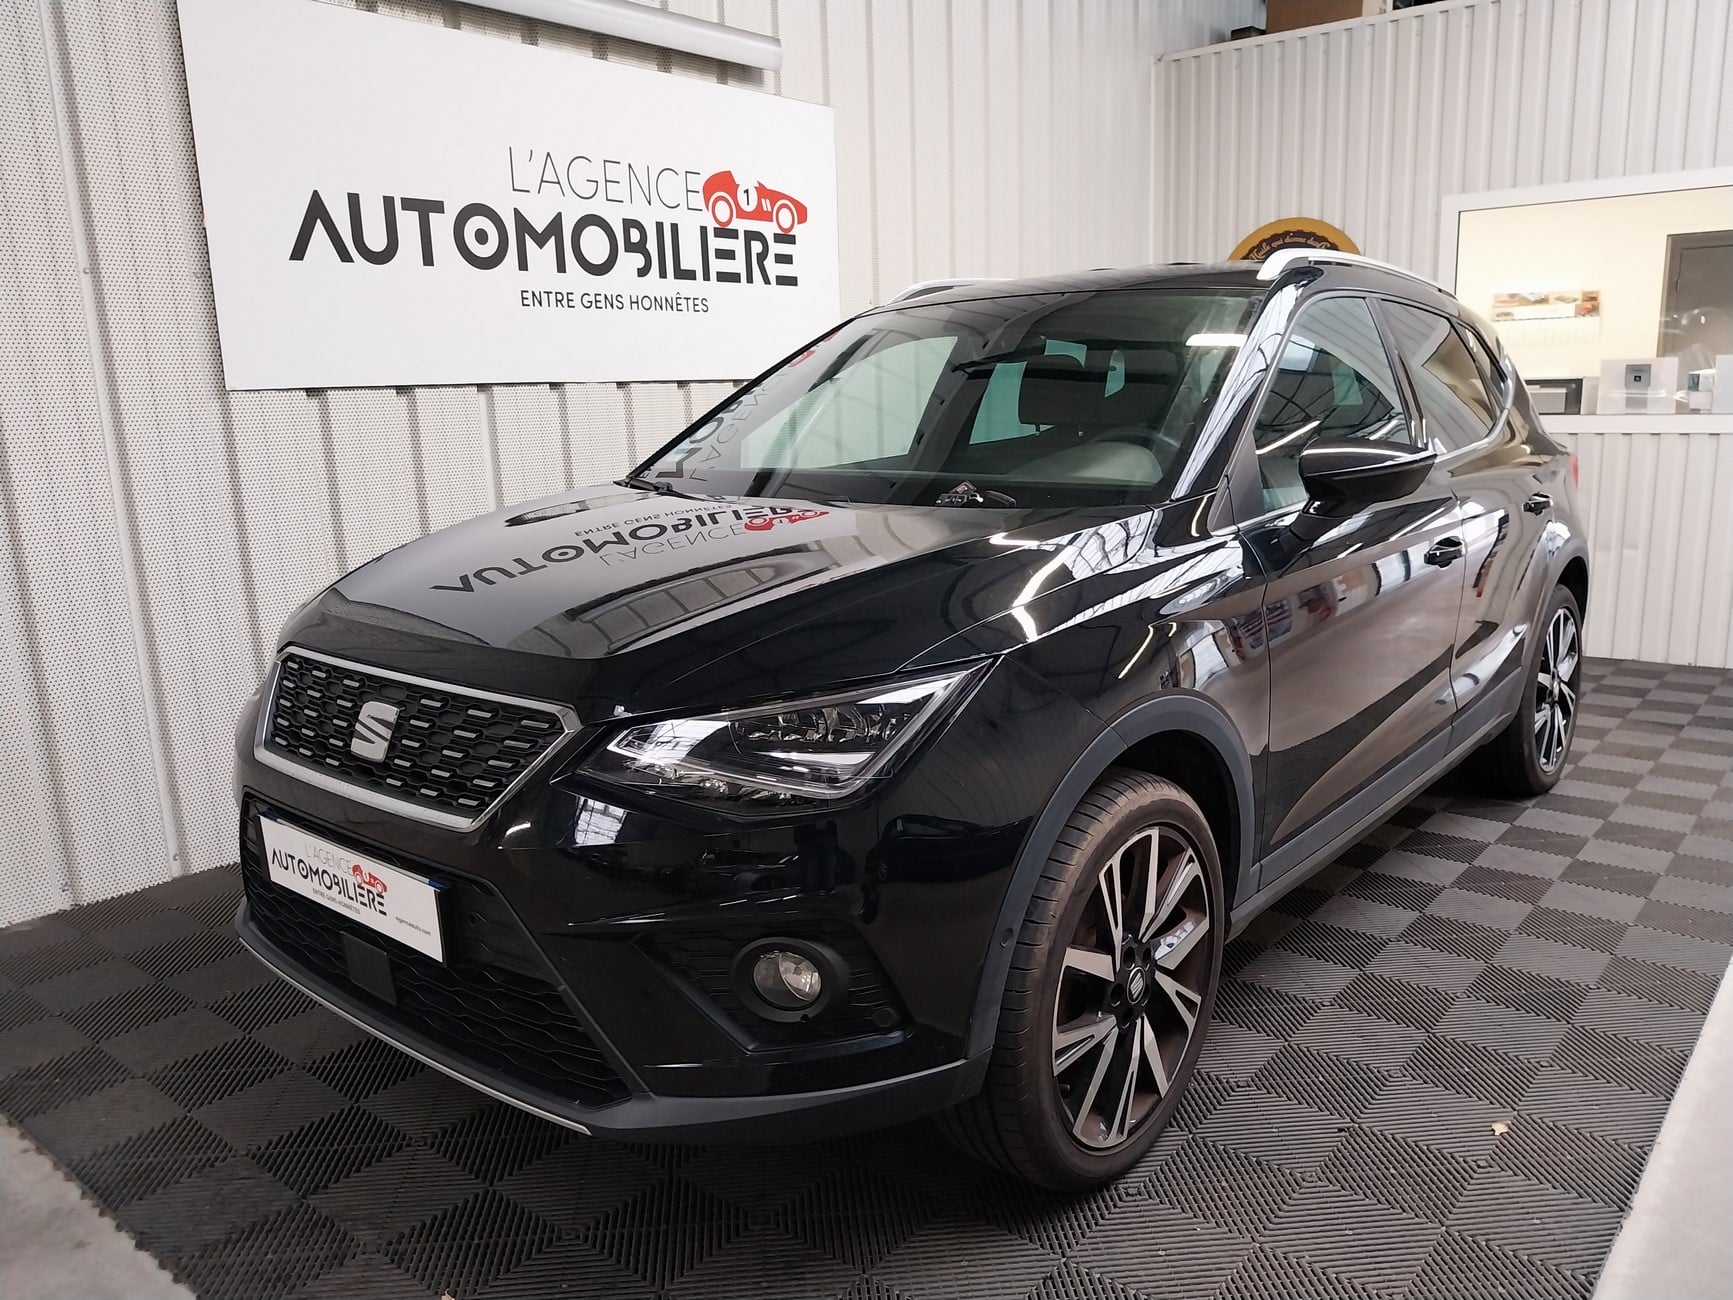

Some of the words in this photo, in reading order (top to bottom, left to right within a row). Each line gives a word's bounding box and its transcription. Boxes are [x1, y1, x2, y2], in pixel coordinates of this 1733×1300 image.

[509, 146, 703, 212] L'AGENCE
[743, 188, 751, 206] 1
[289, 189, 799, 287] AUTOMOBILIERE
[520, 290, 575, 309] ENTRE
[581, 292, 625, 310] GENS
[629, 292, 709, 313] HONNÊTES
